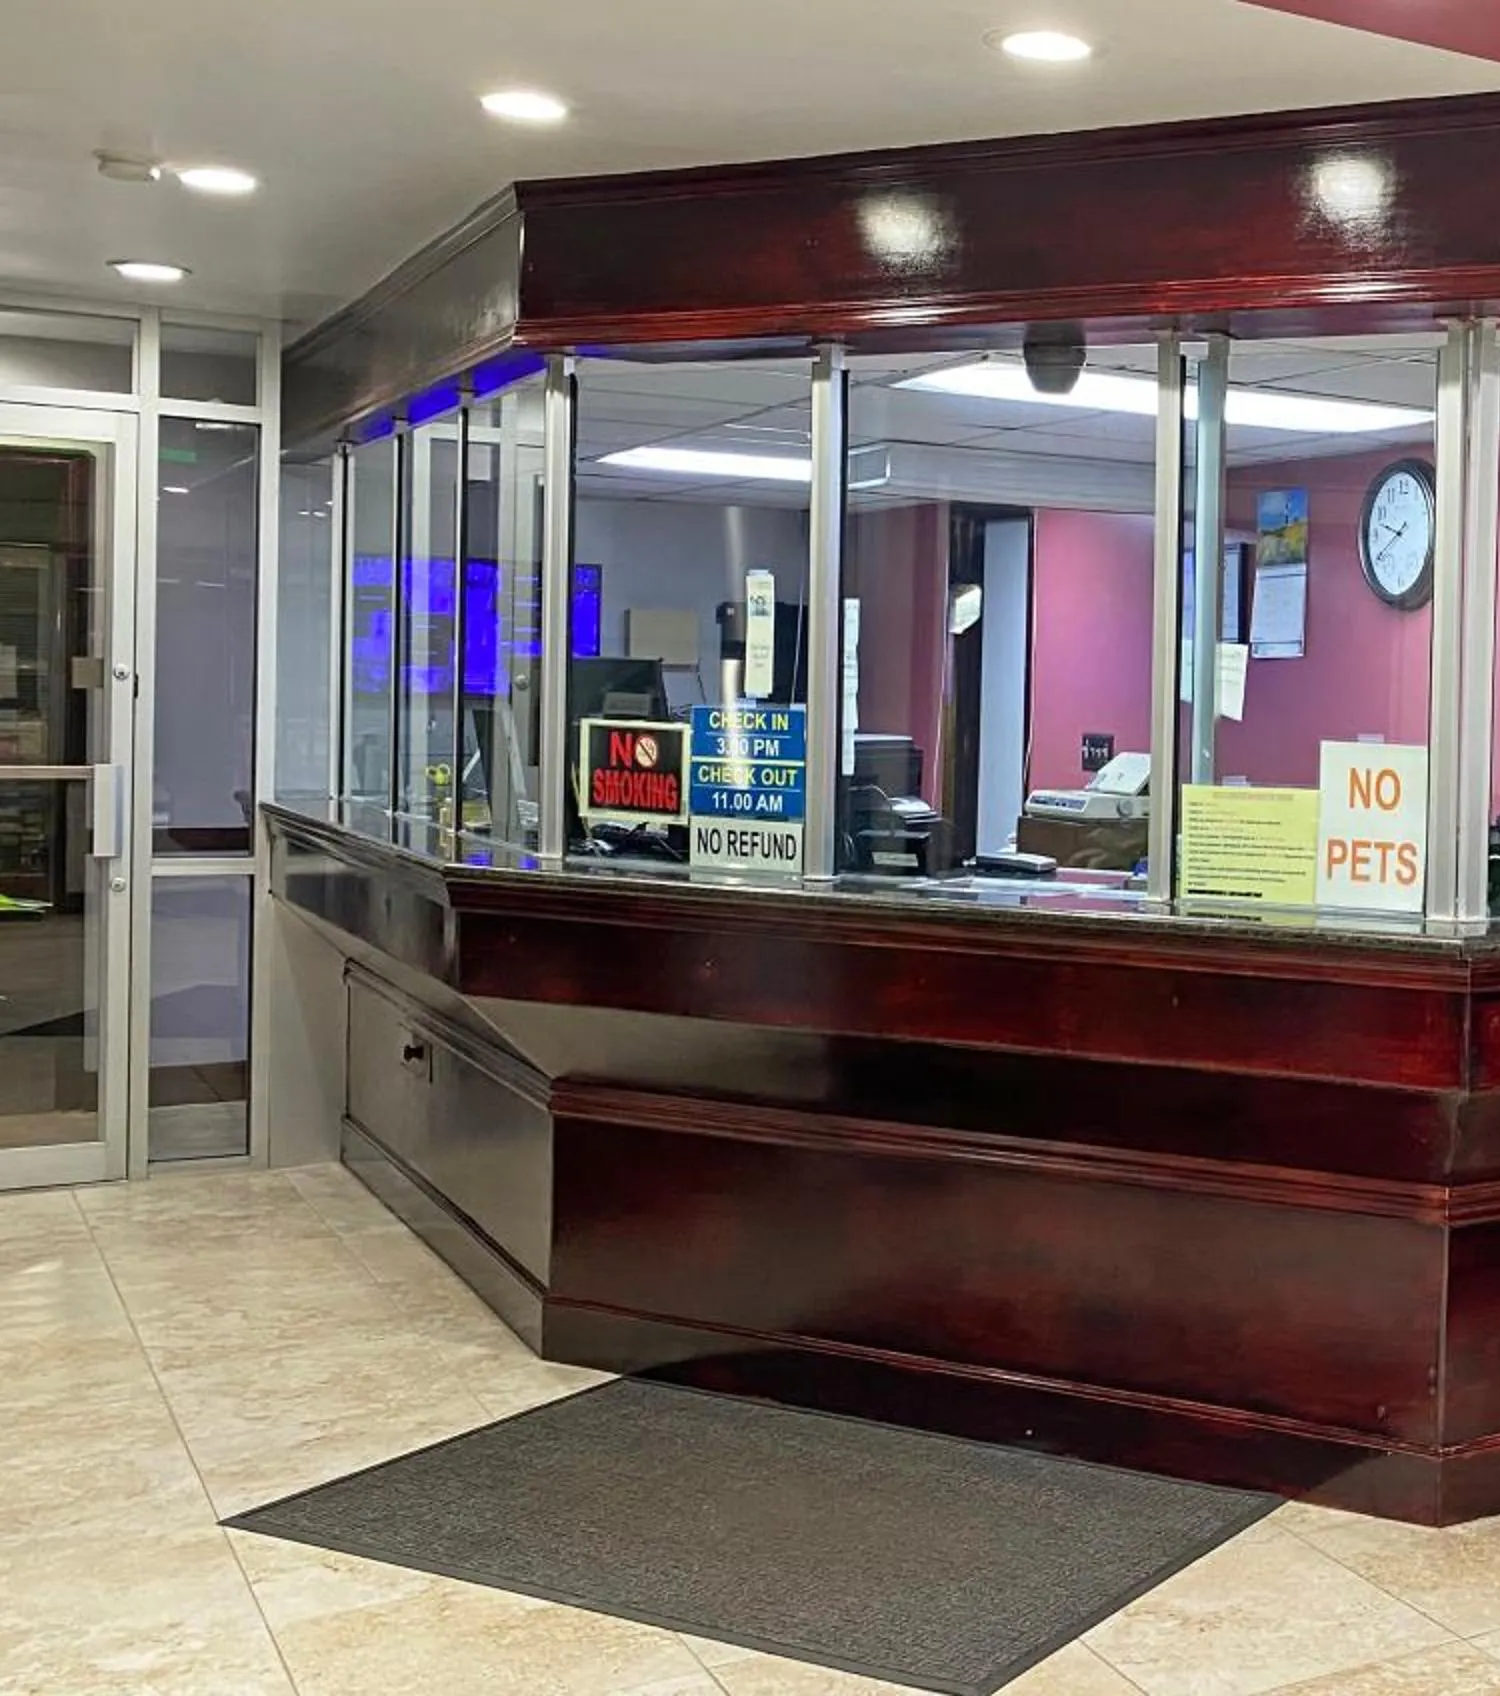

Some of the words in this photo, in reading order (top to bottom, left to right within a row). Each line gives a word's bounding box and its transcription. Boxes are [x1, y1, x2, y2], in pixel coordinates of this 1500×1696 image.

[709, 711, 767, 731] CHECK
[771, 713, 789, 731] IN
[753, 739, 780, 757] PM
[698, 765, 757, 785] CHECK
[761, 768, 799, 786] OUT
[1348, 767, 1401, 811] NO
[592, 769, 679, 811] SMOKING
[711, 791, 753, 812] 11.00
[755, 795, 784, 813] AM
[697, 827, 722, 855] NO
[727, 831, 798, 861] REFUND
[1326, 838, 1419, 886] PETS
